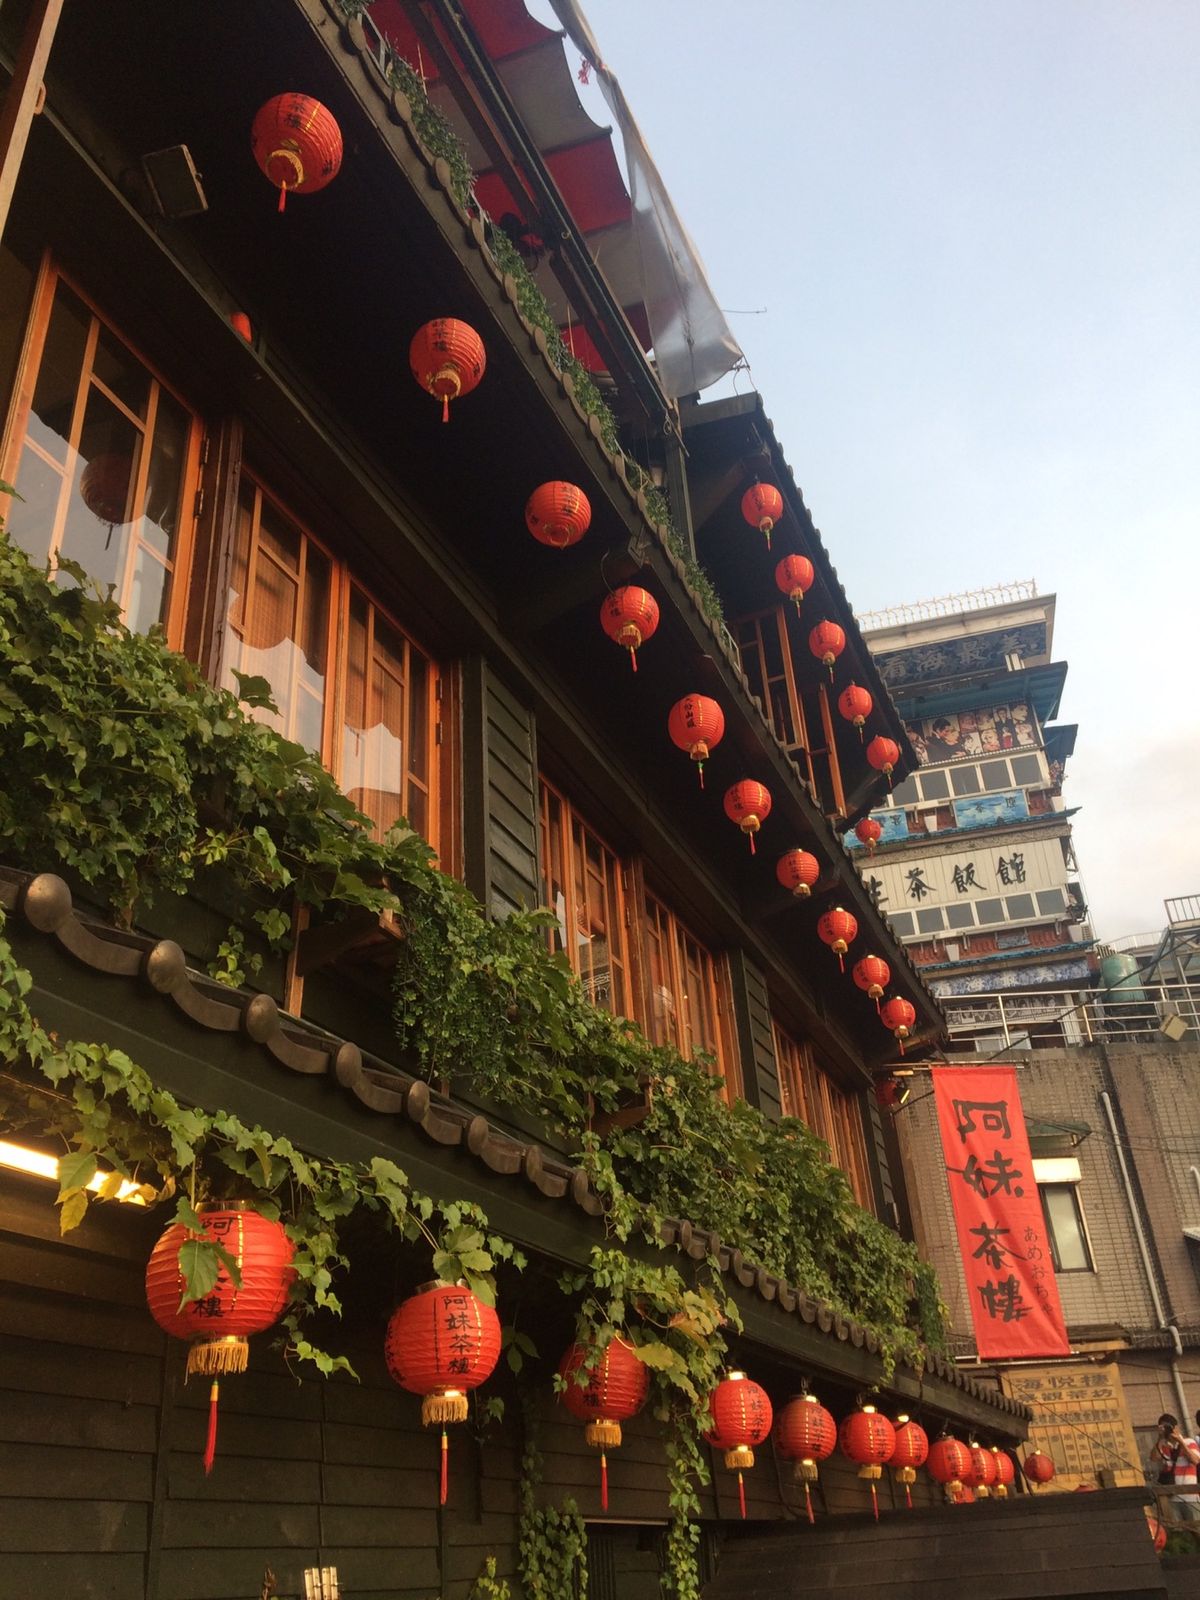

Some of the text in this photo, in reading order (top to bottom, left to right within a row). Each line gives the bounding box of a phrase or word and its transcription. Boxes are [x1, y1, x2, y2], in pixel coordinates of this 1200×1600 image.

[952, 1099, 1032, 1322] 阿妹茶樓
[191, 1215, 235, 1318] 阿樓
[1024, 1226, 1053, 1315] あめおちゃ
[441, 1294, 475, 1375] 阿妹茶樓
